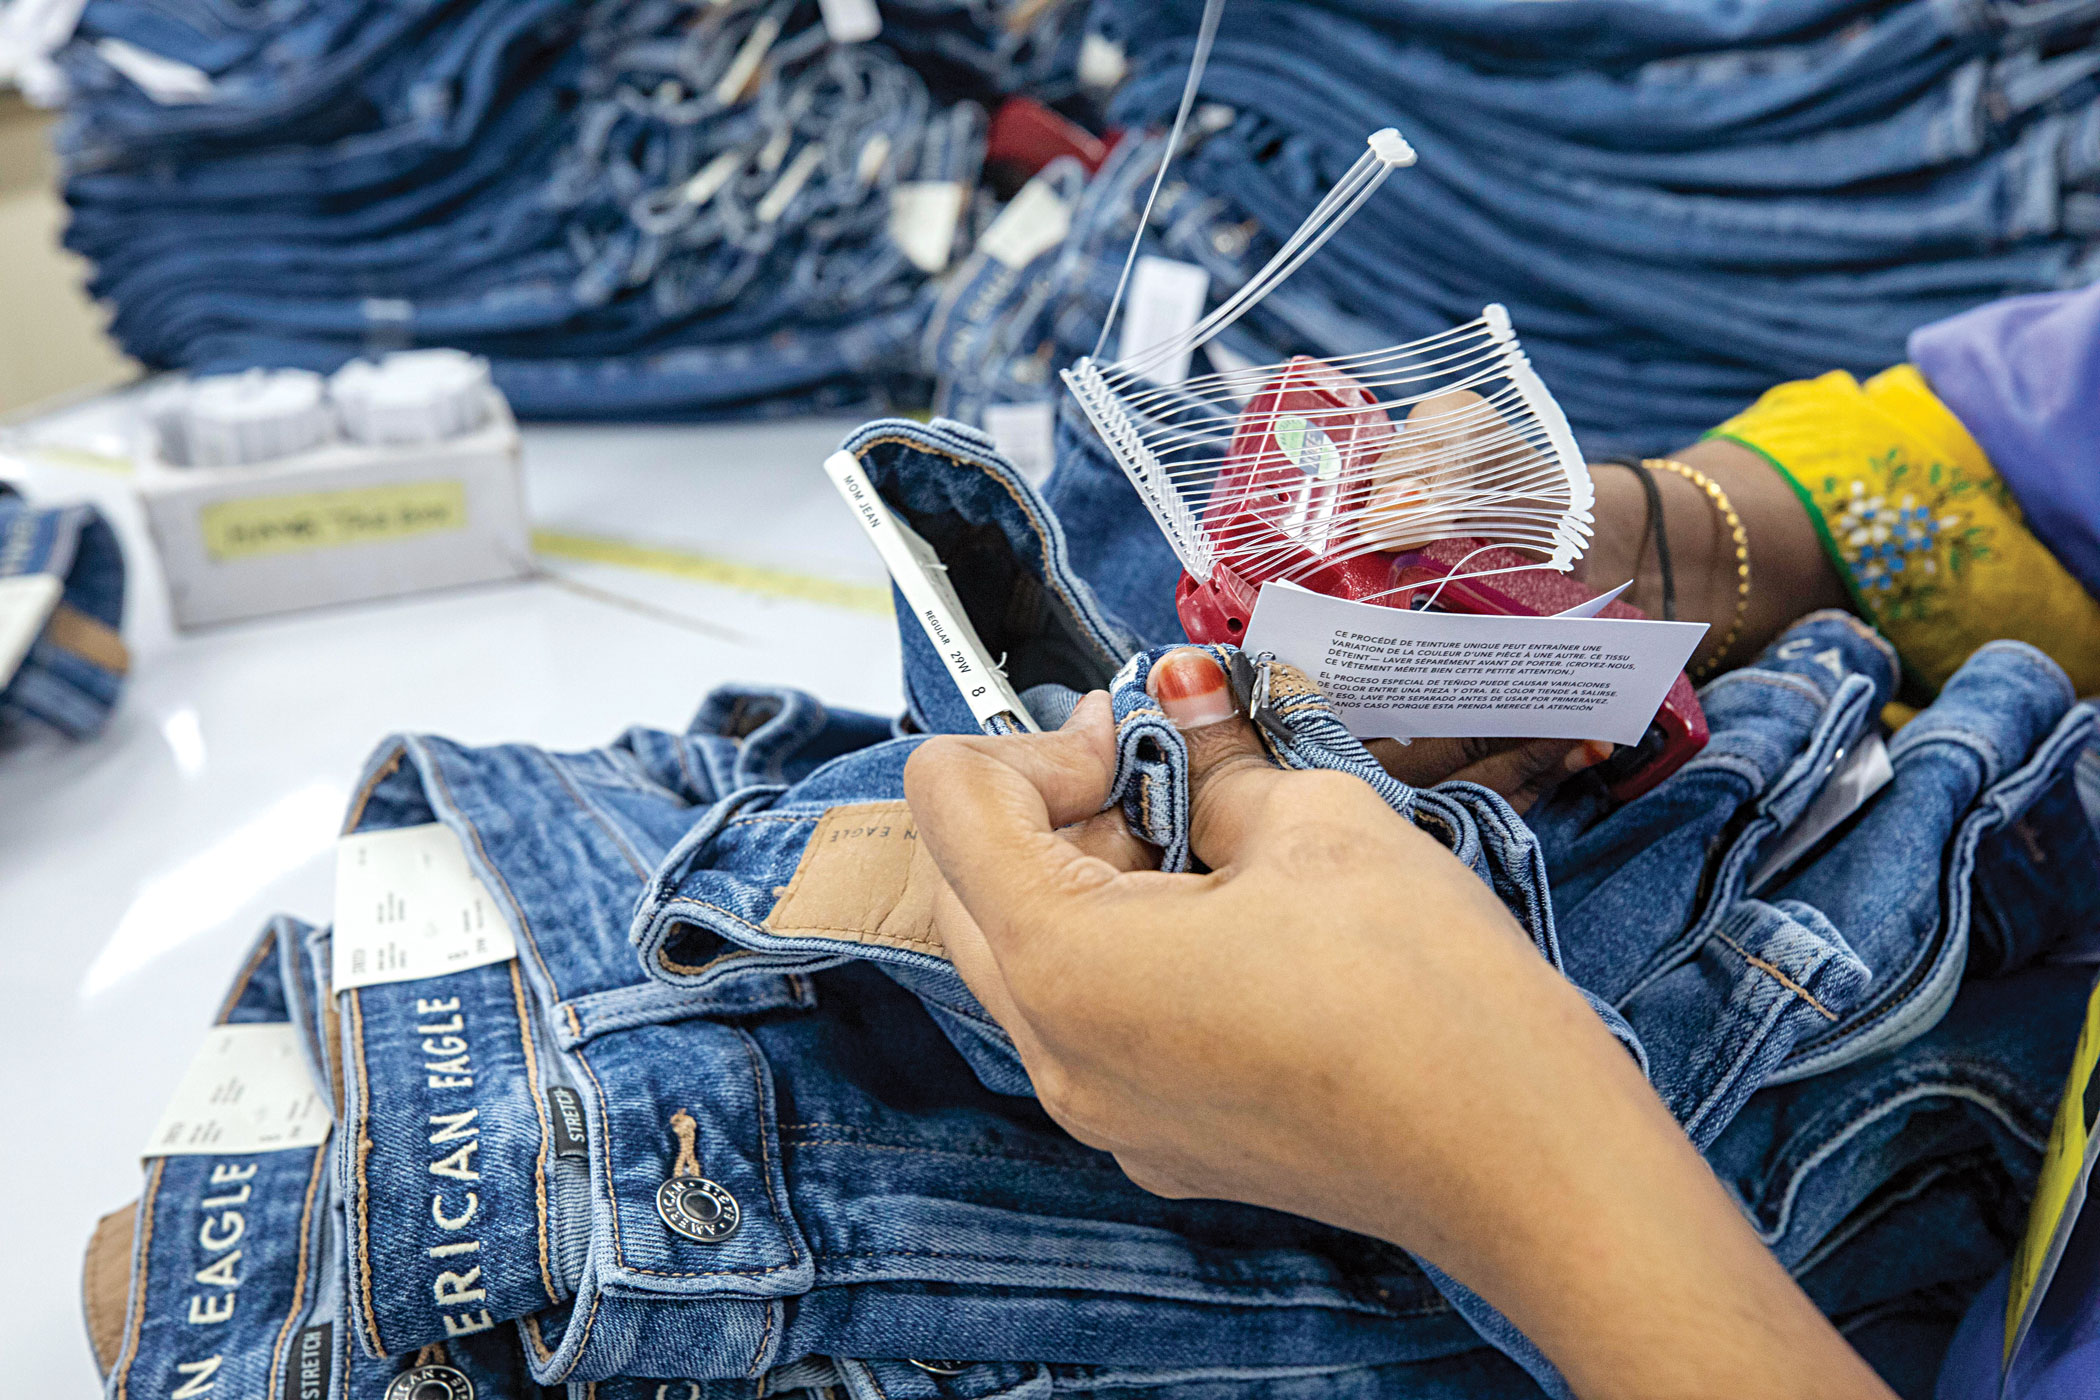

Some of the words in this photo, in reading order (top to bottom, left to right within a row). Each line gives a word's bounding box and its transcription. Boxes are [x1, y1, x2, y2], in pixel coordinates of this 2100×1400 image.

[843, 475, 864, 502] MOM
[858, 501, 881, 529] JEAN
[1332, 639, 1386, 654] VARIATION
[1335, 630, 1347, 638] CE
[1350, 633, 1397, 646] PROCÉDÉ
[1399, 639, 1413, 647] DE
[924, 609, 951, 646] REGULAR
[950, 650, 972, 675] 29W
[971, 686, 986, 698] 8
[1325, 657, 1338, 666] CE
[1341, 659, 1392, 672] VÊTEMENT
[1415, 658, 1476, 666] SÉPARÉMENT
[1566, 661, 1636, 670] (CROYEZ-NOUS,
[1317, 680, 1331, 689] DE
[1332, 683, 1366, 692] COLOR
[1580, 689, 1618, 697] SALIRSE.
[1320, 671, 1331, 679] EL
[1334, 674, 1379, 684] PROCESO
[1551, 681, 1611, 689] VARIACIONES
[1335, 692, 1357, 700] ESO,
[830, 826, 891, 843] EAGLE
[417, 996, 474, 1089] EAGLE
[662, 1181, 716, 1236] AMERICAN
[188, 1163, 258, 1324] EAGLE
[301, 1331, 322, 1400] STRETCH
